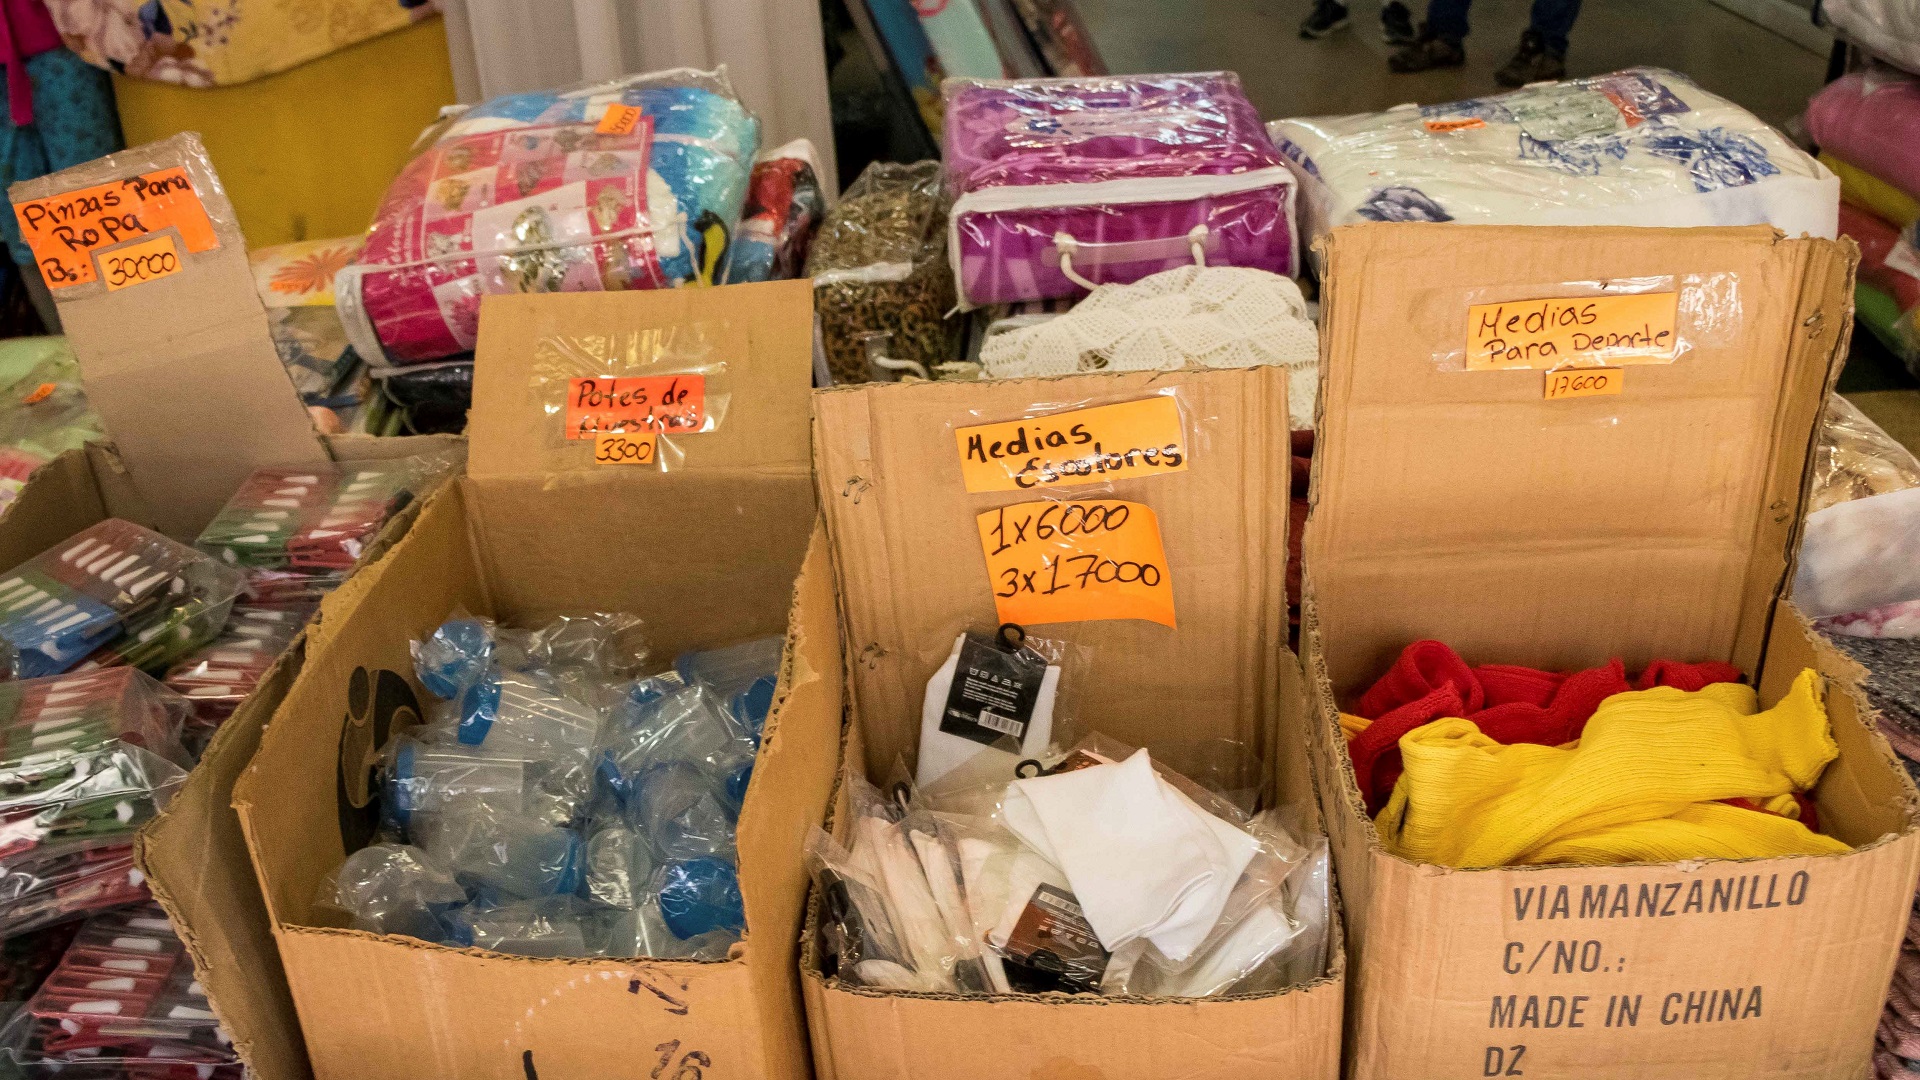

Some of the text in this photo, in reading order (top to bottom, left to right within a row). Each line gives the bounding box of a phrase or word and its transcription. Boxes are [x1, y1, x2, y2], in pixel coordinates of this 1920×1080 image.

[23, 175, 191, 231] Pinzas Para
[52, 213, 149, 251] Ropa
[108, 252, 176, 286] 30000
[1478, 303, 1597, 338] Medias
[1484, 338, 1558, 363] Para
[577, 378, 689, 408] Potes de
[1551, 374, 1608, 397] 17600
[596, 438, 651, 462] 3300
[967, 423, 1093, 464] Medias
[1579, 869, 1812, 920] MANZANILLO
[1488, 985, 1763, 1029] MADE IN CHINA
[1482, 1044, 1527, 1078] DZ
